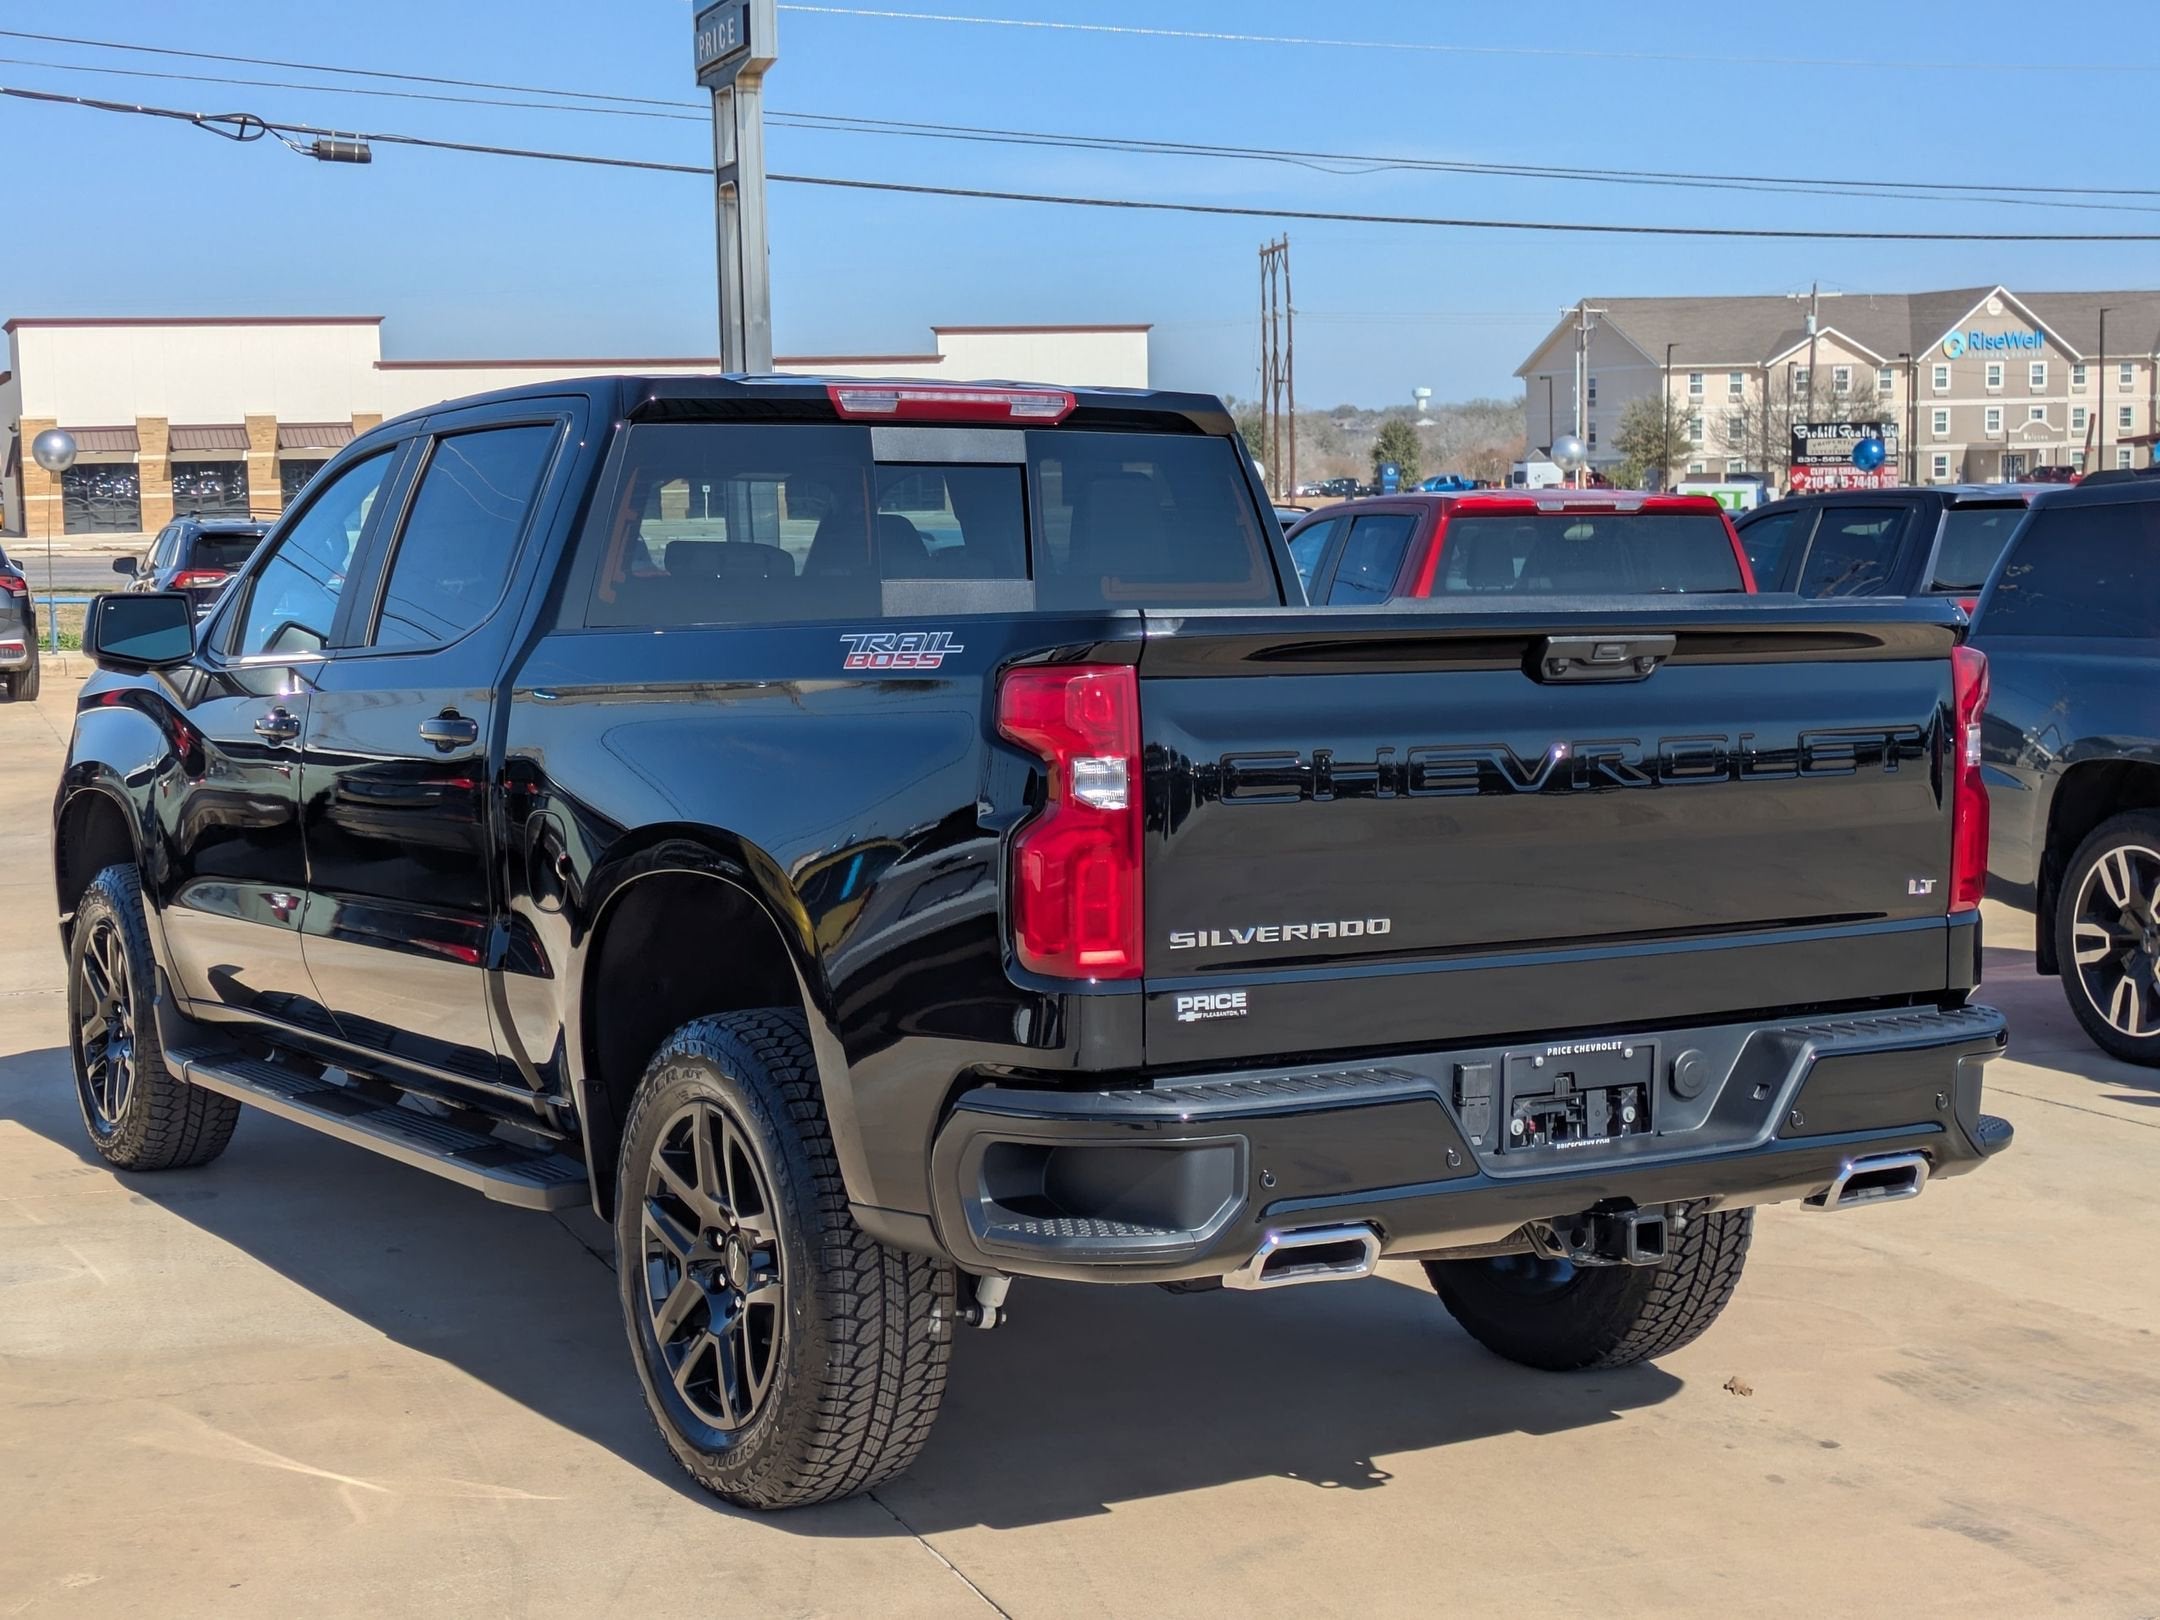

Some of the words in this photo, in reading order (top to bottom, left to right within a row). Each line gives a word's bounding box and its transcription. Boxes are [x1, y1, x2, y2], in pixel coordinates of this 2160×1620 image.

[698, 17, 735, 60] PRICE
[1968, 328, 2045, 350] RiseWell
[840, 631, 964, 653] TRAIL
[843, 651, 945, 669] BOSS
[1220, 724, 1920, 805] CHEVROLET
[1908, 879, 1937, 895] LT
[1169, 918, 1391, 950] SILVERADO
[1177, 992, 1247, 1012] PRICE
[1547, 1046, 1572, 1057] PRICE
[1574, 1041, 1622, 1054] CHEVROLET
